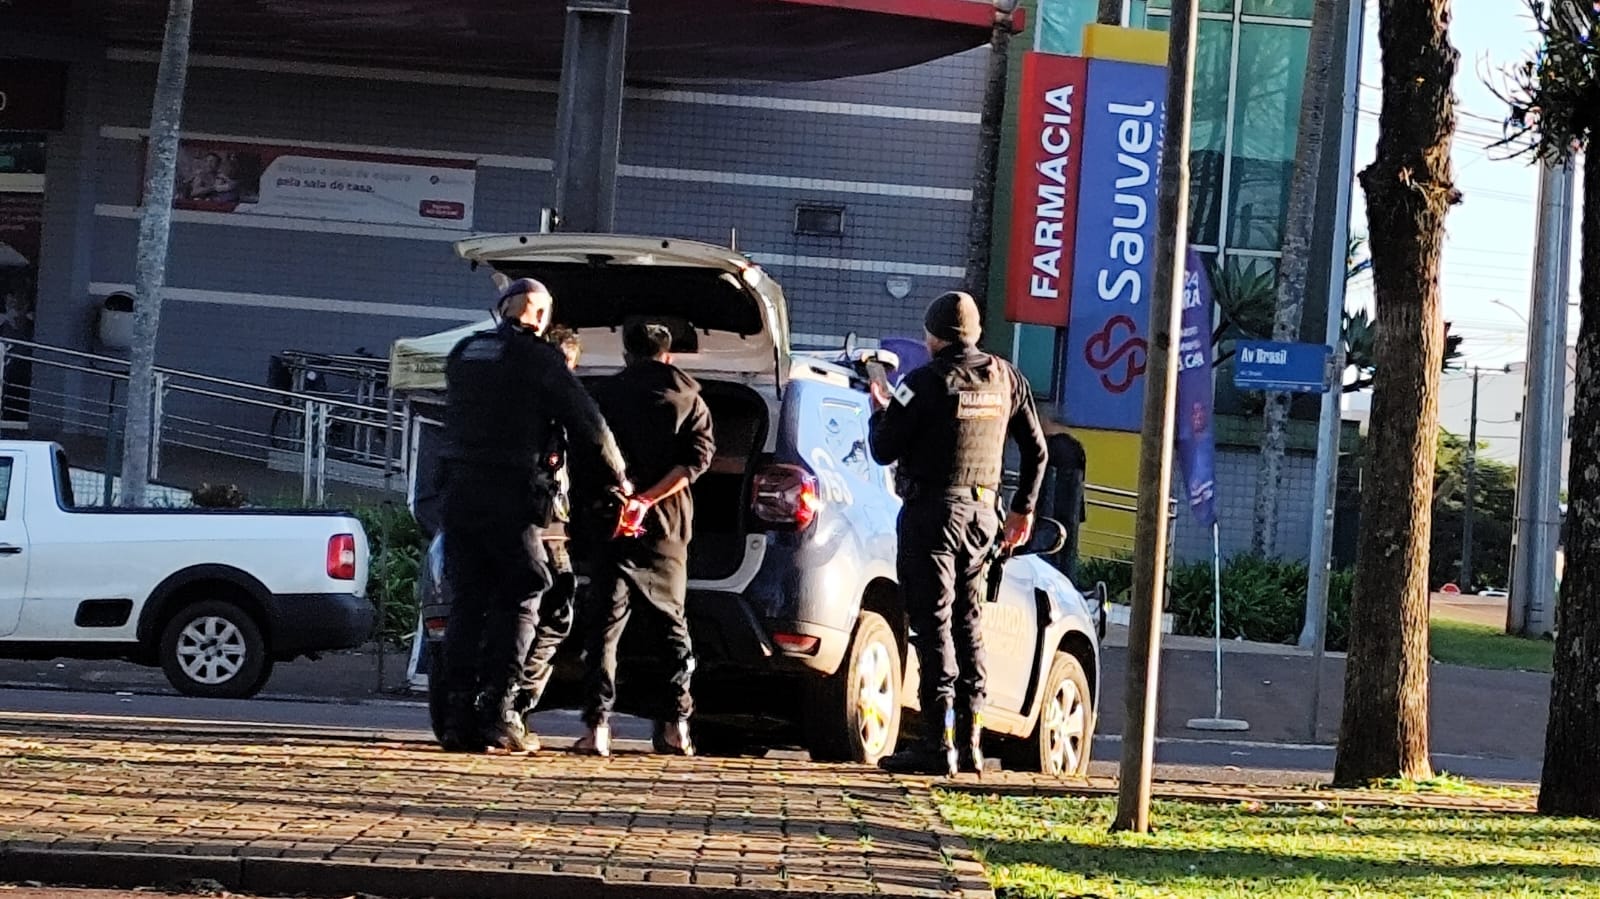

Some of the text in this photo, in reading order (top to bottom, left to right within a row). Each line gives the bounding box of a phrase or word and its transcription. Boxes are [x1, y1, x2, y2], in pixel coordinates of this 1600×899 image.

[1030, 84, 1075, 299] FARMÁCIA
[1098, 100, 1155, 305] Sauvel
[1241, 347, 1287, 365] Av Brasil
